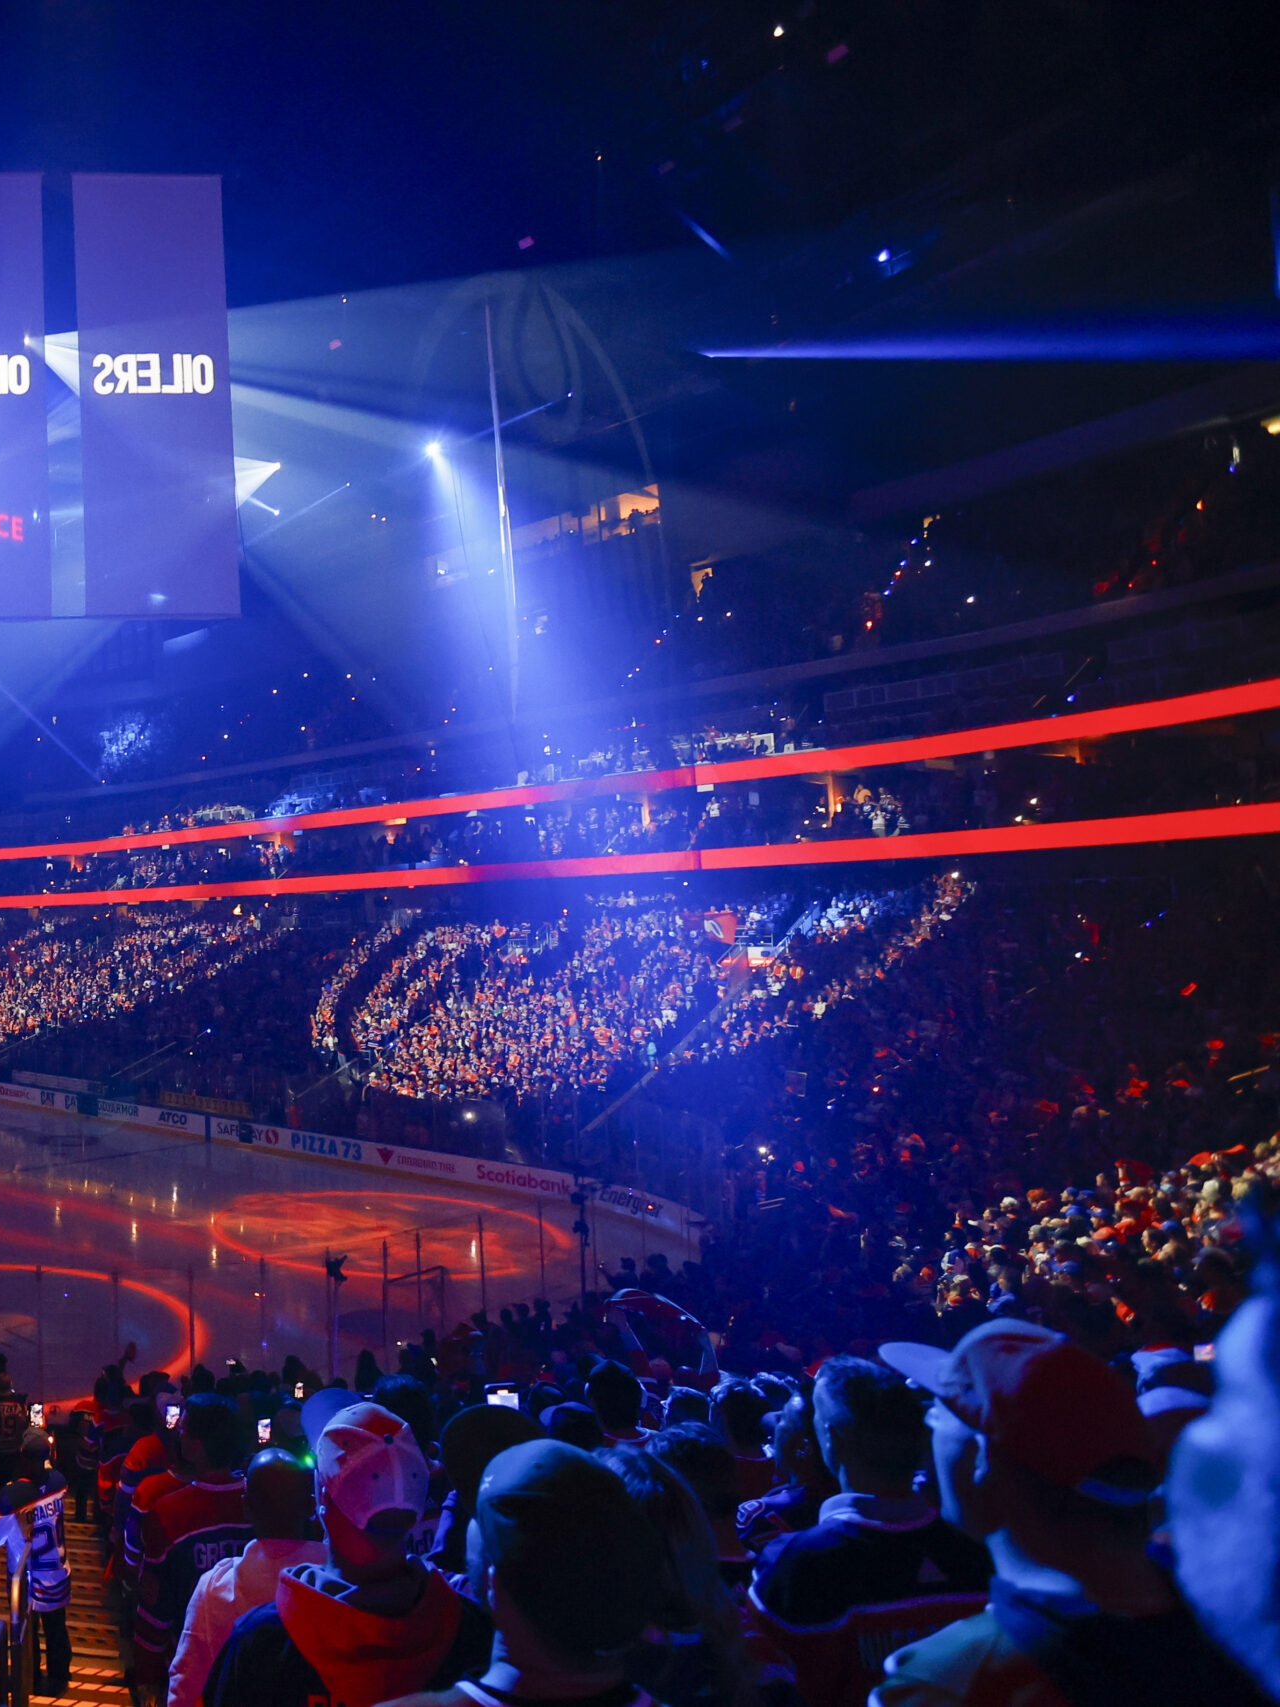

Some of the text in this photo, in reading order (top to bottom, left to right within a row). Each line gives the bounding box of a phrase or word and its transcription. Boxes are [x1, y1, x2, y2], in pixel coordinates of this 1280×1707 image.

[40, 1091, 55, 1106] CAT
[64, 1094, 78, 1109] CA
[158, 1111, 187, 1125] ATCO
[217, 1122, 264, 1142] SAFEAY
[291, 1132, 362, 1161] PIZZA 73
[477, 1164, 571, 1195] Scotiabank
[193, 1539, 246, 1569] GRET
